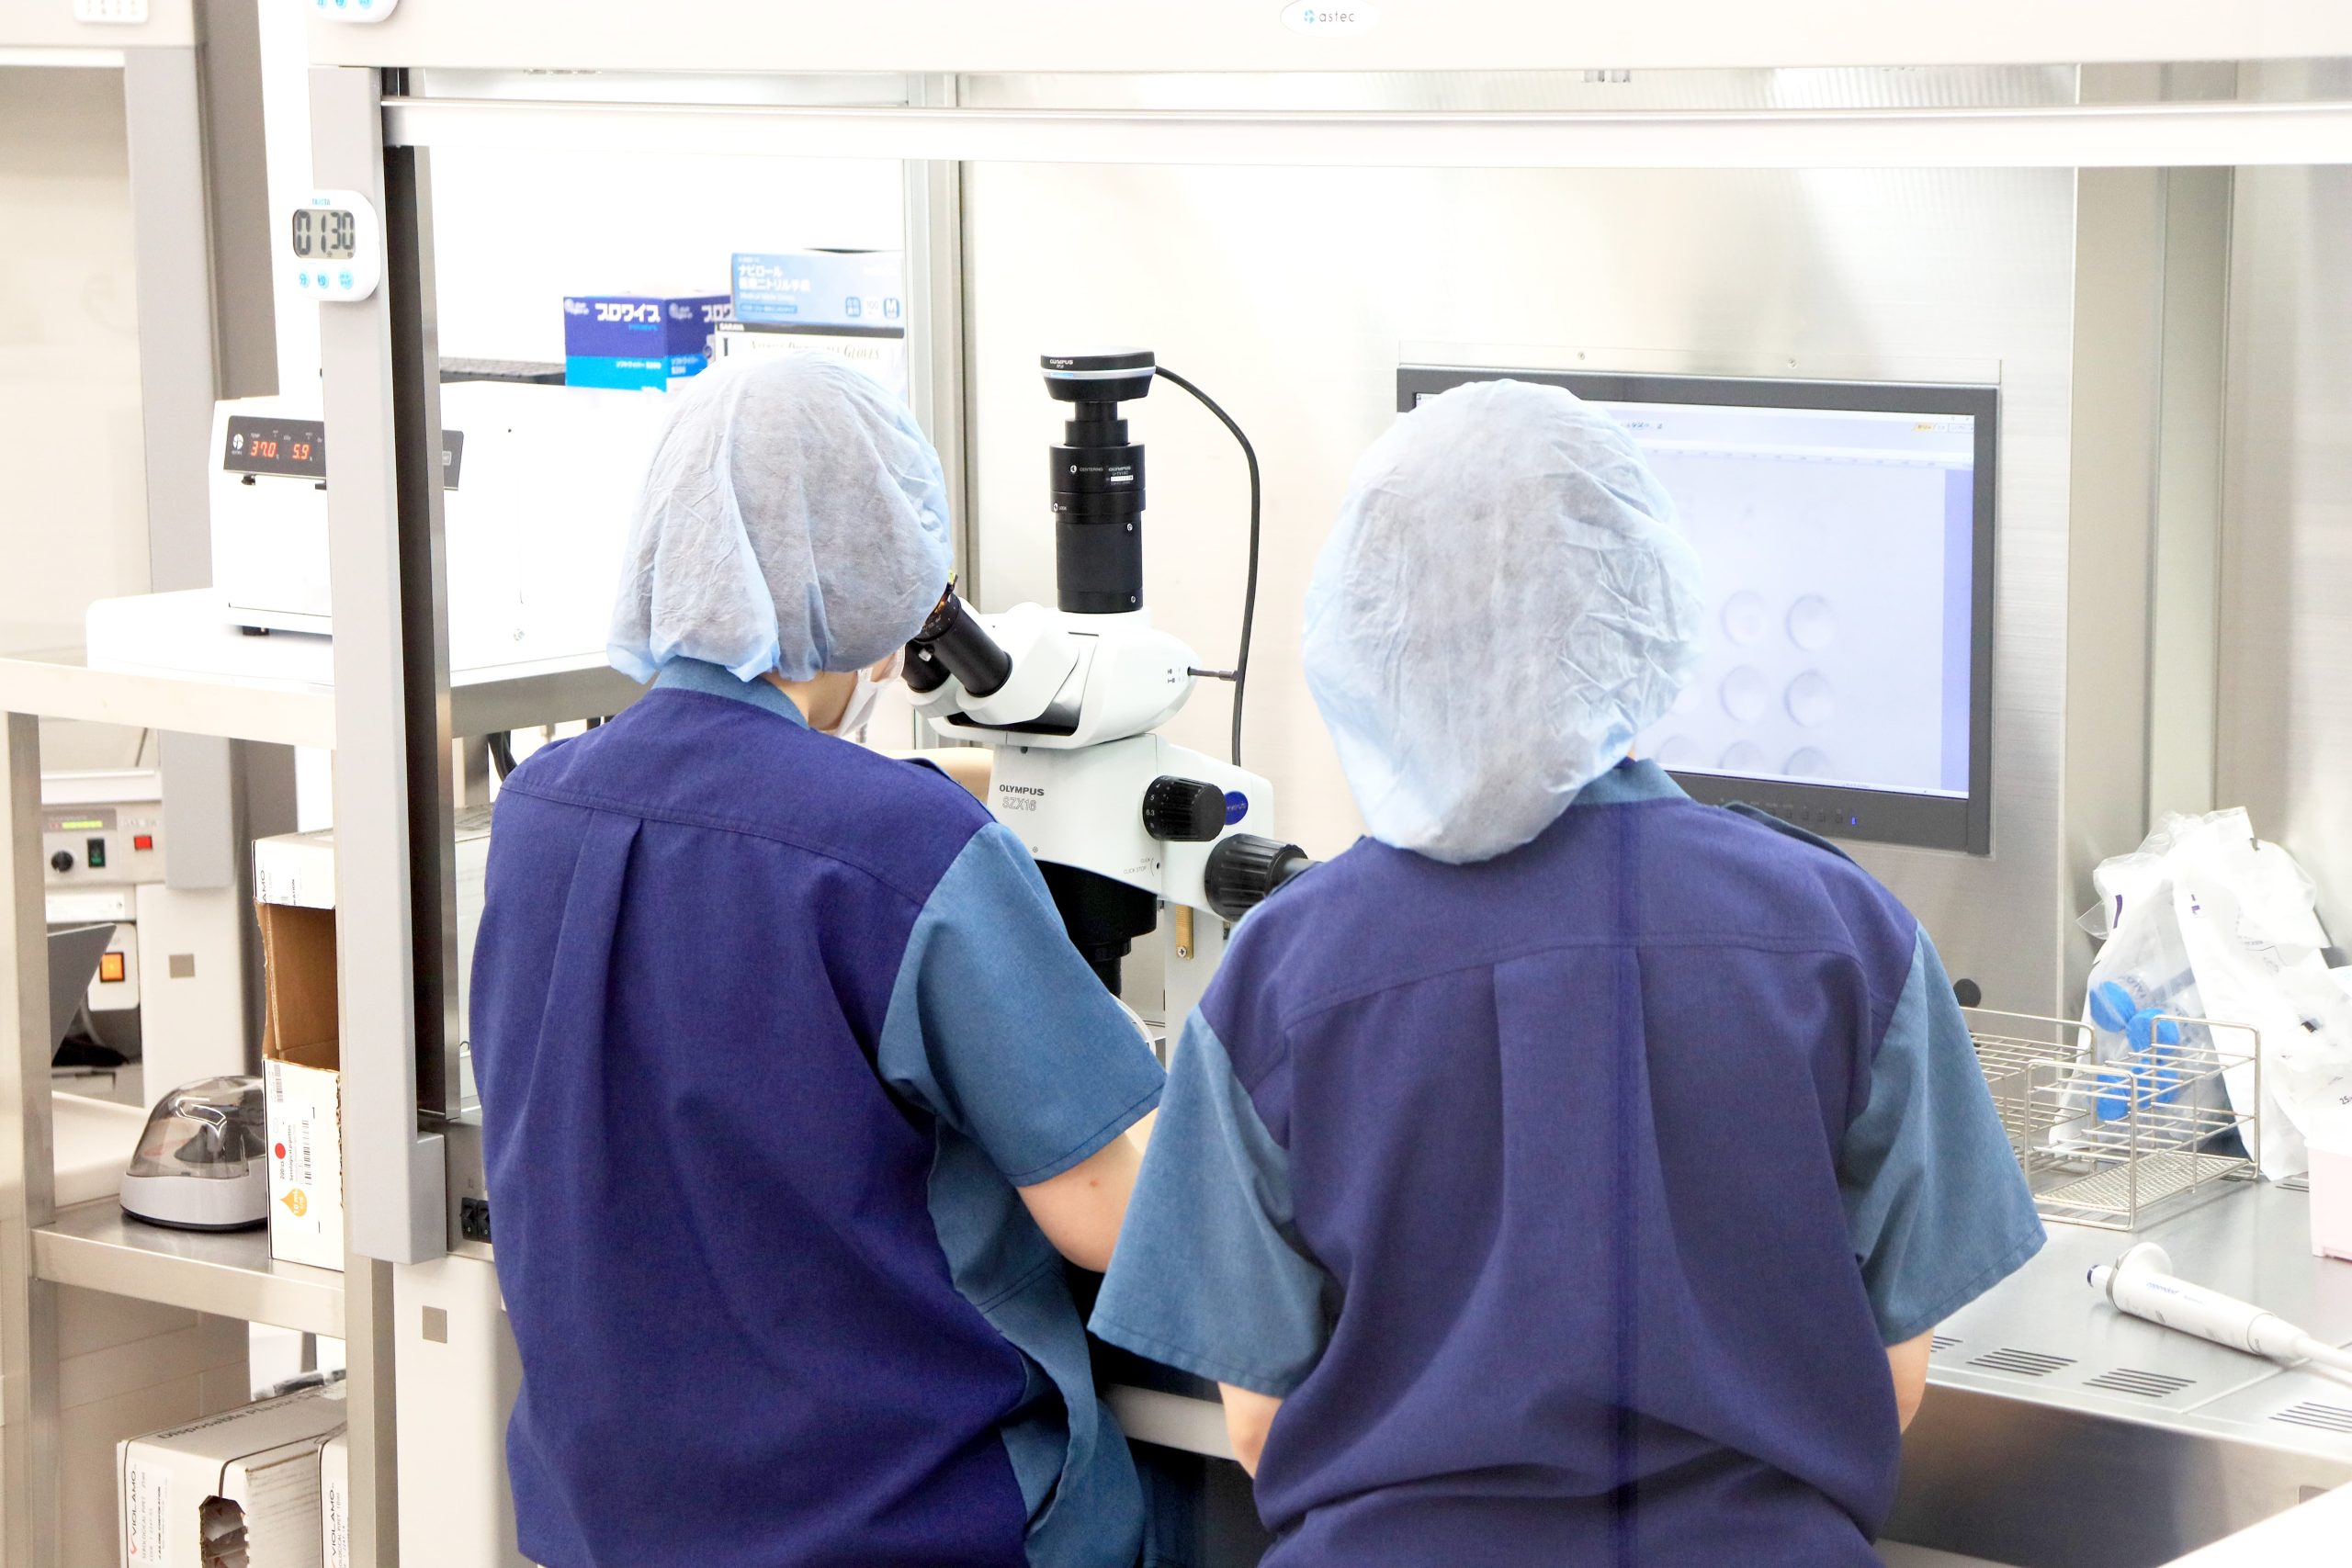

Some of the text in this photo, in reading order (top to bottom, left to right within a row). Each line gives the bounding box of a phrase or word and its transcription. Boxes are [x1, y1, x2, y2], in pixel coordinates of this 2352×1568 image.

[1319, 10, 1355, 22] astec
[1000, 784, 1045, 796] OLYMPUS
[1002, 796, 1037, 811] SZX16
[157, 1413, 247, 1439] Disposable
